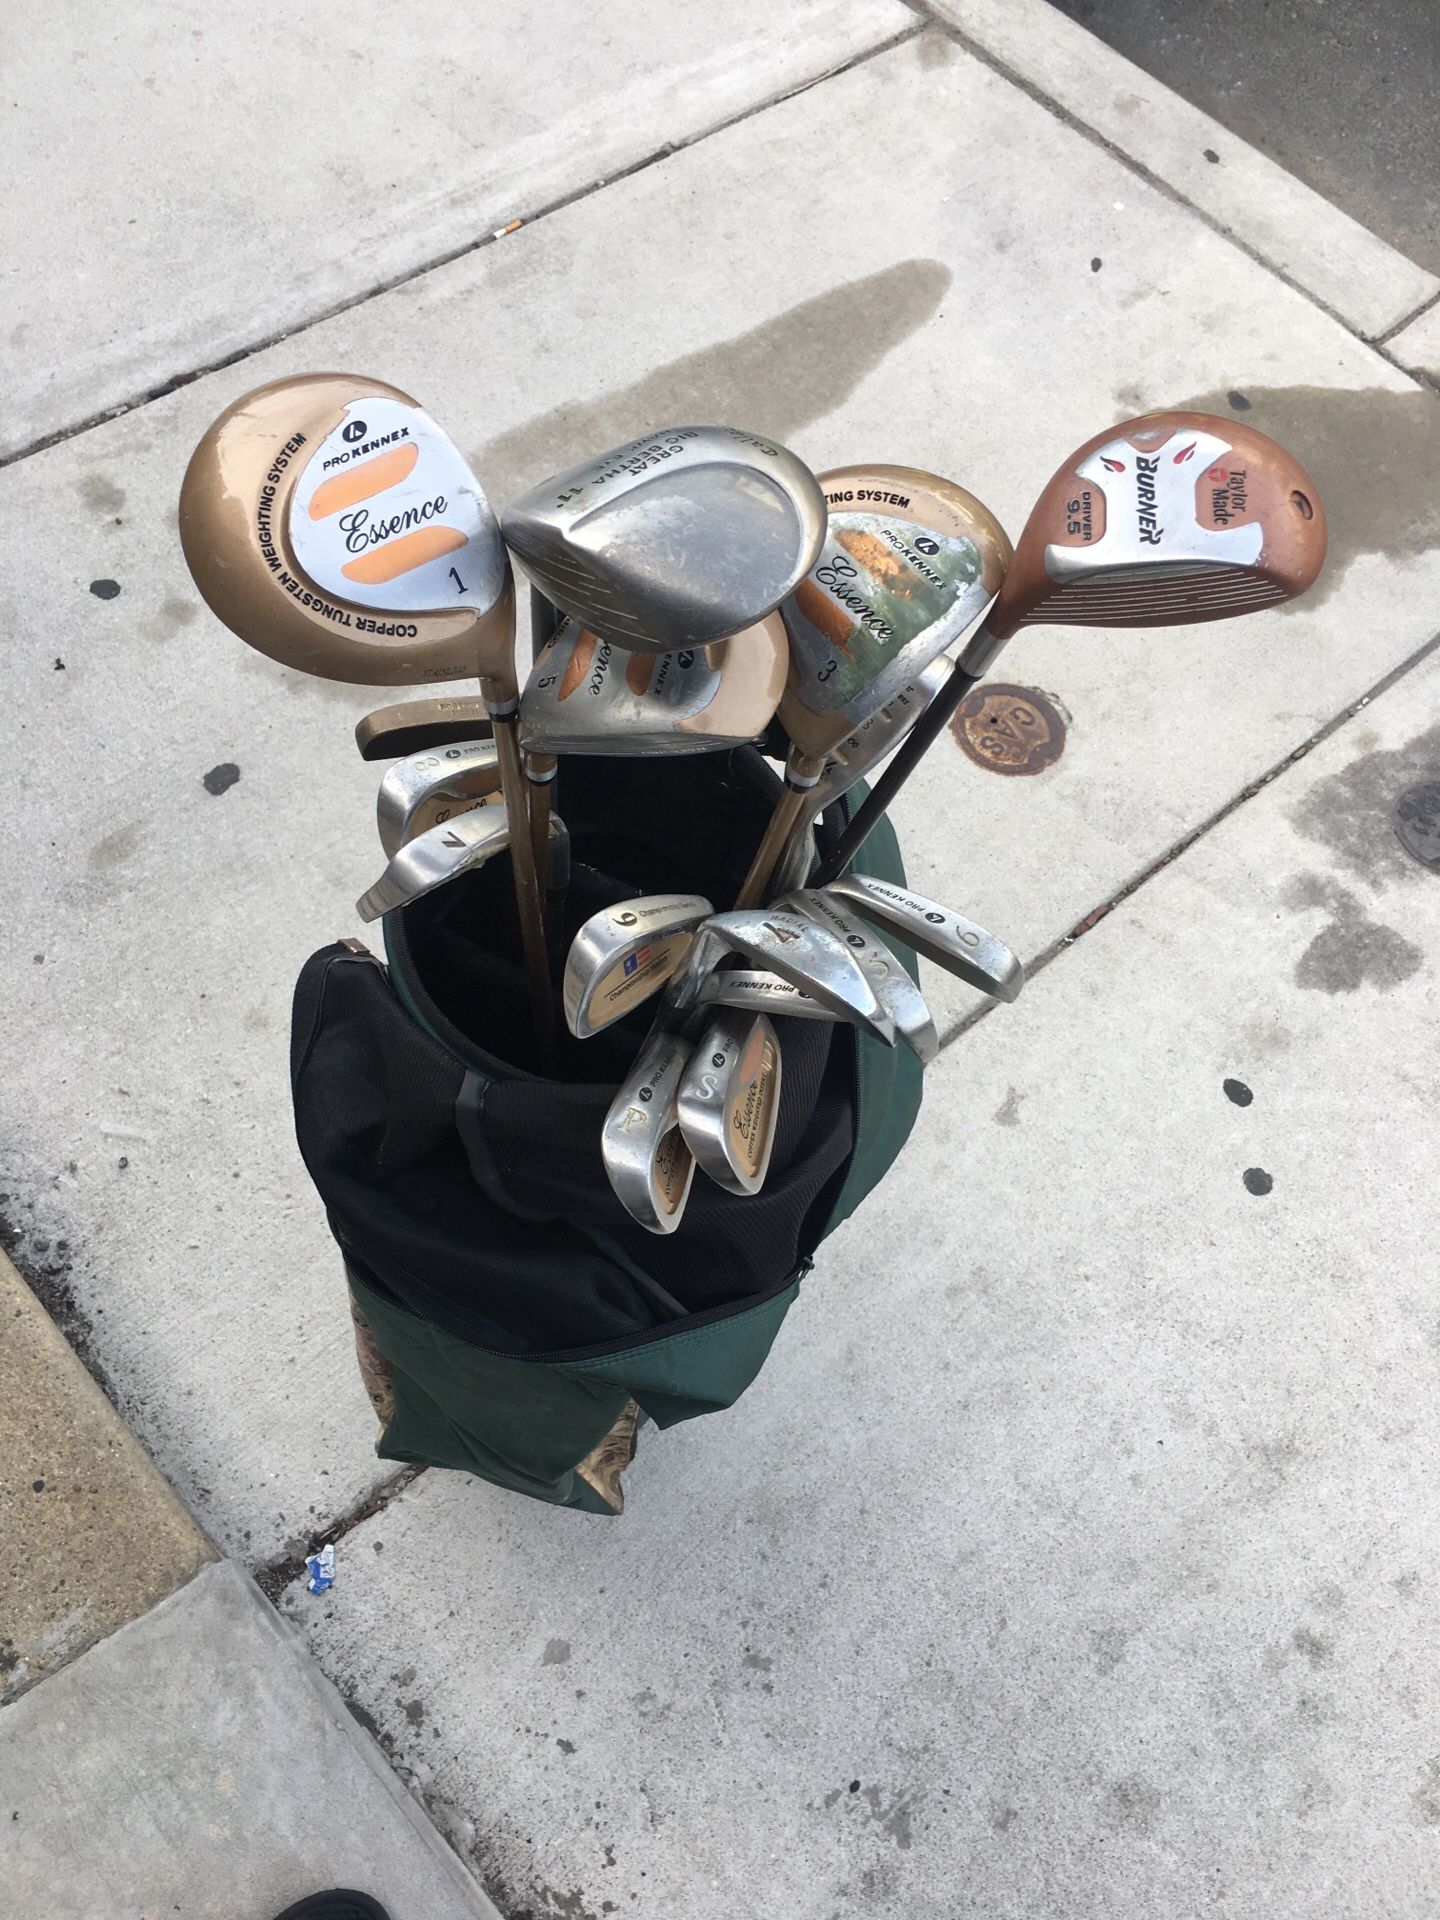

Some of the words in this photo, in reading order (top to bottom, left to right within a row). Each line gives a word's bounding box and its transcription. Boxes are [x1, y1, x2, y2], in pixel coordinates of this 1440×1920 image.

[322, 426, 410, 471] PROKENNEX
[665, 431, 699, 445] BIG
[270, 432, 307, 489] SYSTEM
[592, 445, 663, 485] BERTHA
[630, 445, 684, 476] GREAT
[856, 489, 910, 509] SYSTEM
[1135, 455, 1164, 546] BURNER
[1228, 470, 1249, 513] Taylor
[1067, 499, 1081, 536] 9.5
[1082, 491, 1092, 542] DRIVER
[1212, 488, 1229, 526] Made
[257, 485, 283, 573] WEIGHTING
[339, 495, 448, 554] Essence
[881, 529, 947, 591] PROKENNEX
[449, 567, 468, 595] 1
[278, 572, 352, 627] TUNGSTEN
[815, 555, 895, 640] Essence
[356, 616, 418, 638] COPPER
[538, 675, 558, 688] 5
[818, 659, 838, 682] 3
[415, 756, 440, 772] 8
[866, 883, 907, 902] KENNEX
[905, 899, 926, 913] PRO
[809, 897, 837, 920] KENNEX
[834, 918, 851, 934] PRO
[729, 981, 774, 990] KENNEX
[774, 984, 796, 993] PRO
[722, 1038, 734, 1053] PRO
[651, 1072, 663, 1088] PRO
[695, 1074, 719, 1100] S
[617, 1106, 648, 1135] P
[733, 1079, 758, 1140] Essence
